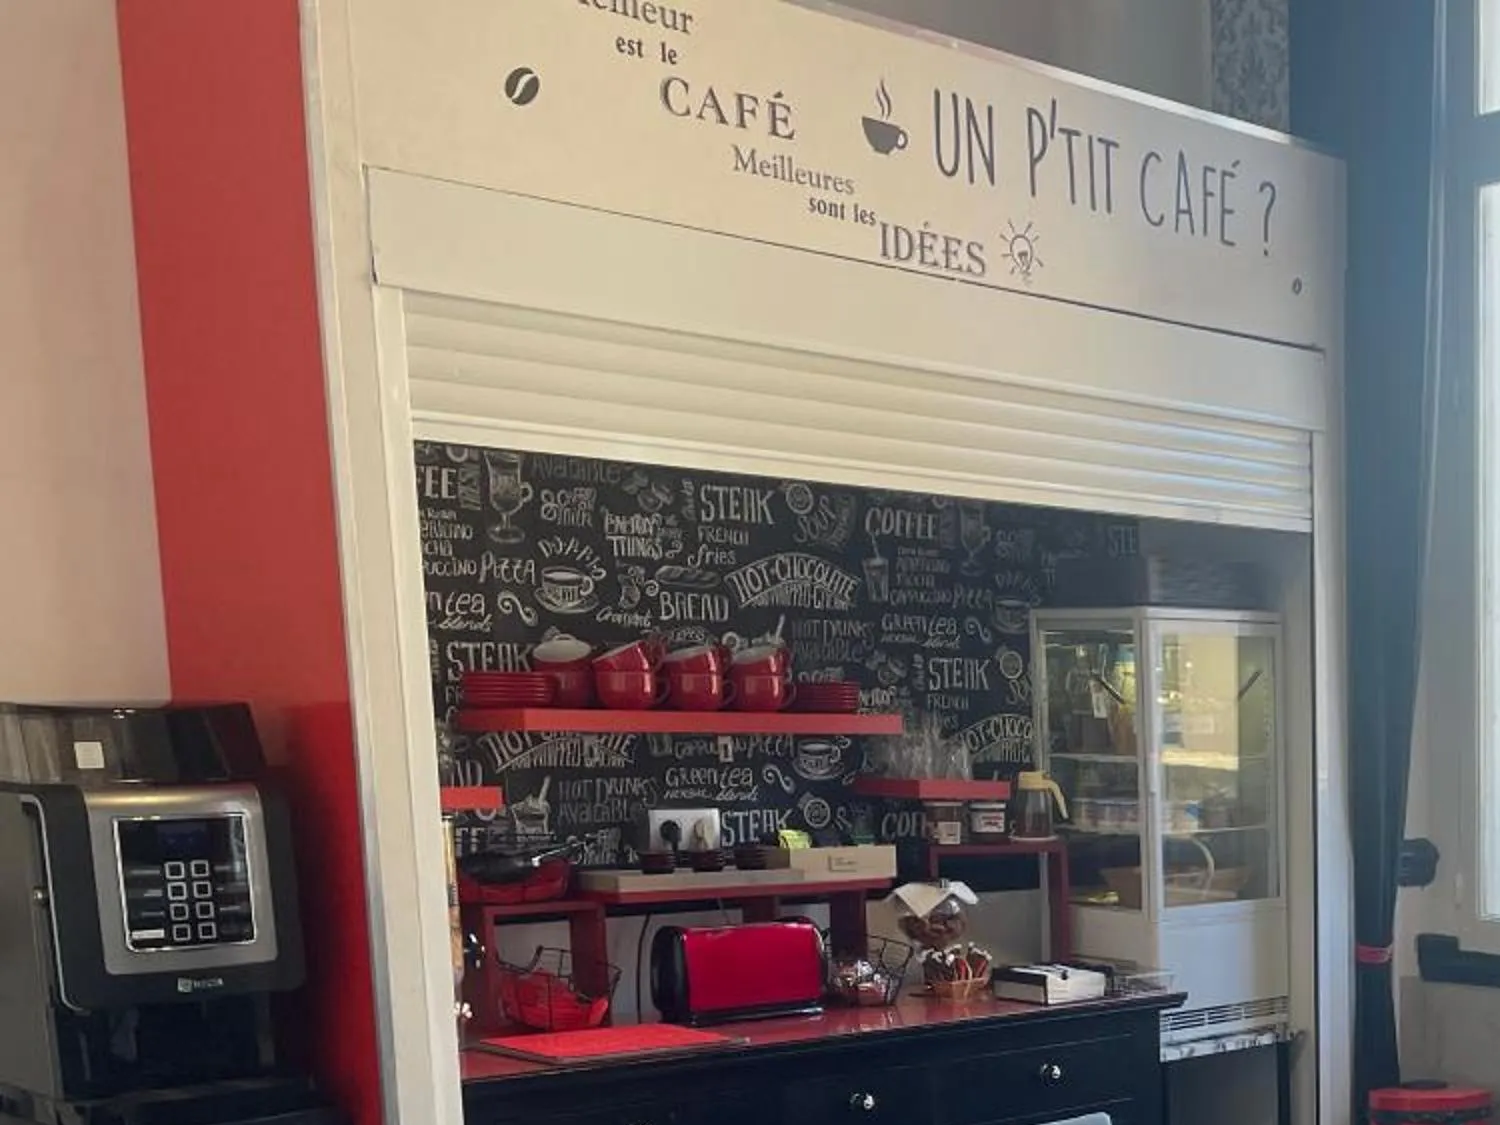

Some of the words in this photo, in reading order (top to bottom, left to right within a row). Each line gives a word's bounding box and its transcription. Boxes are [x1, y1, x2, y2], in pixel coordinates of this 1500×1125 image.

[615, 36, 644, 58] est
[660, 41, 678, 65] le
[660, 76, 796, 140] CAFÉ
[732, 144, 856, 196] Meilleures
[934, 88, 996, 186] UN
[1026, 98, 1120, 214] P'TIT
[1140, 149, 1242, 247] CAFÉ
[1259, 180, 1277, 257] ?
[808, 197, 845, 221] sont
[853, 203, 877, 227] les
[879, 222, 986, 277] IDÉES
[700, 485, 776, 525] STEAK
[865, 507, 941, 540] COFFEE
[479, 550, 537, 586] PIZZA
[659, 592, 730, 624] BREAD
[446, 641, 536, 680] STEAK
[928, 656, 991, 692] STEAK
[720, 808, 795, 847] STEAK
